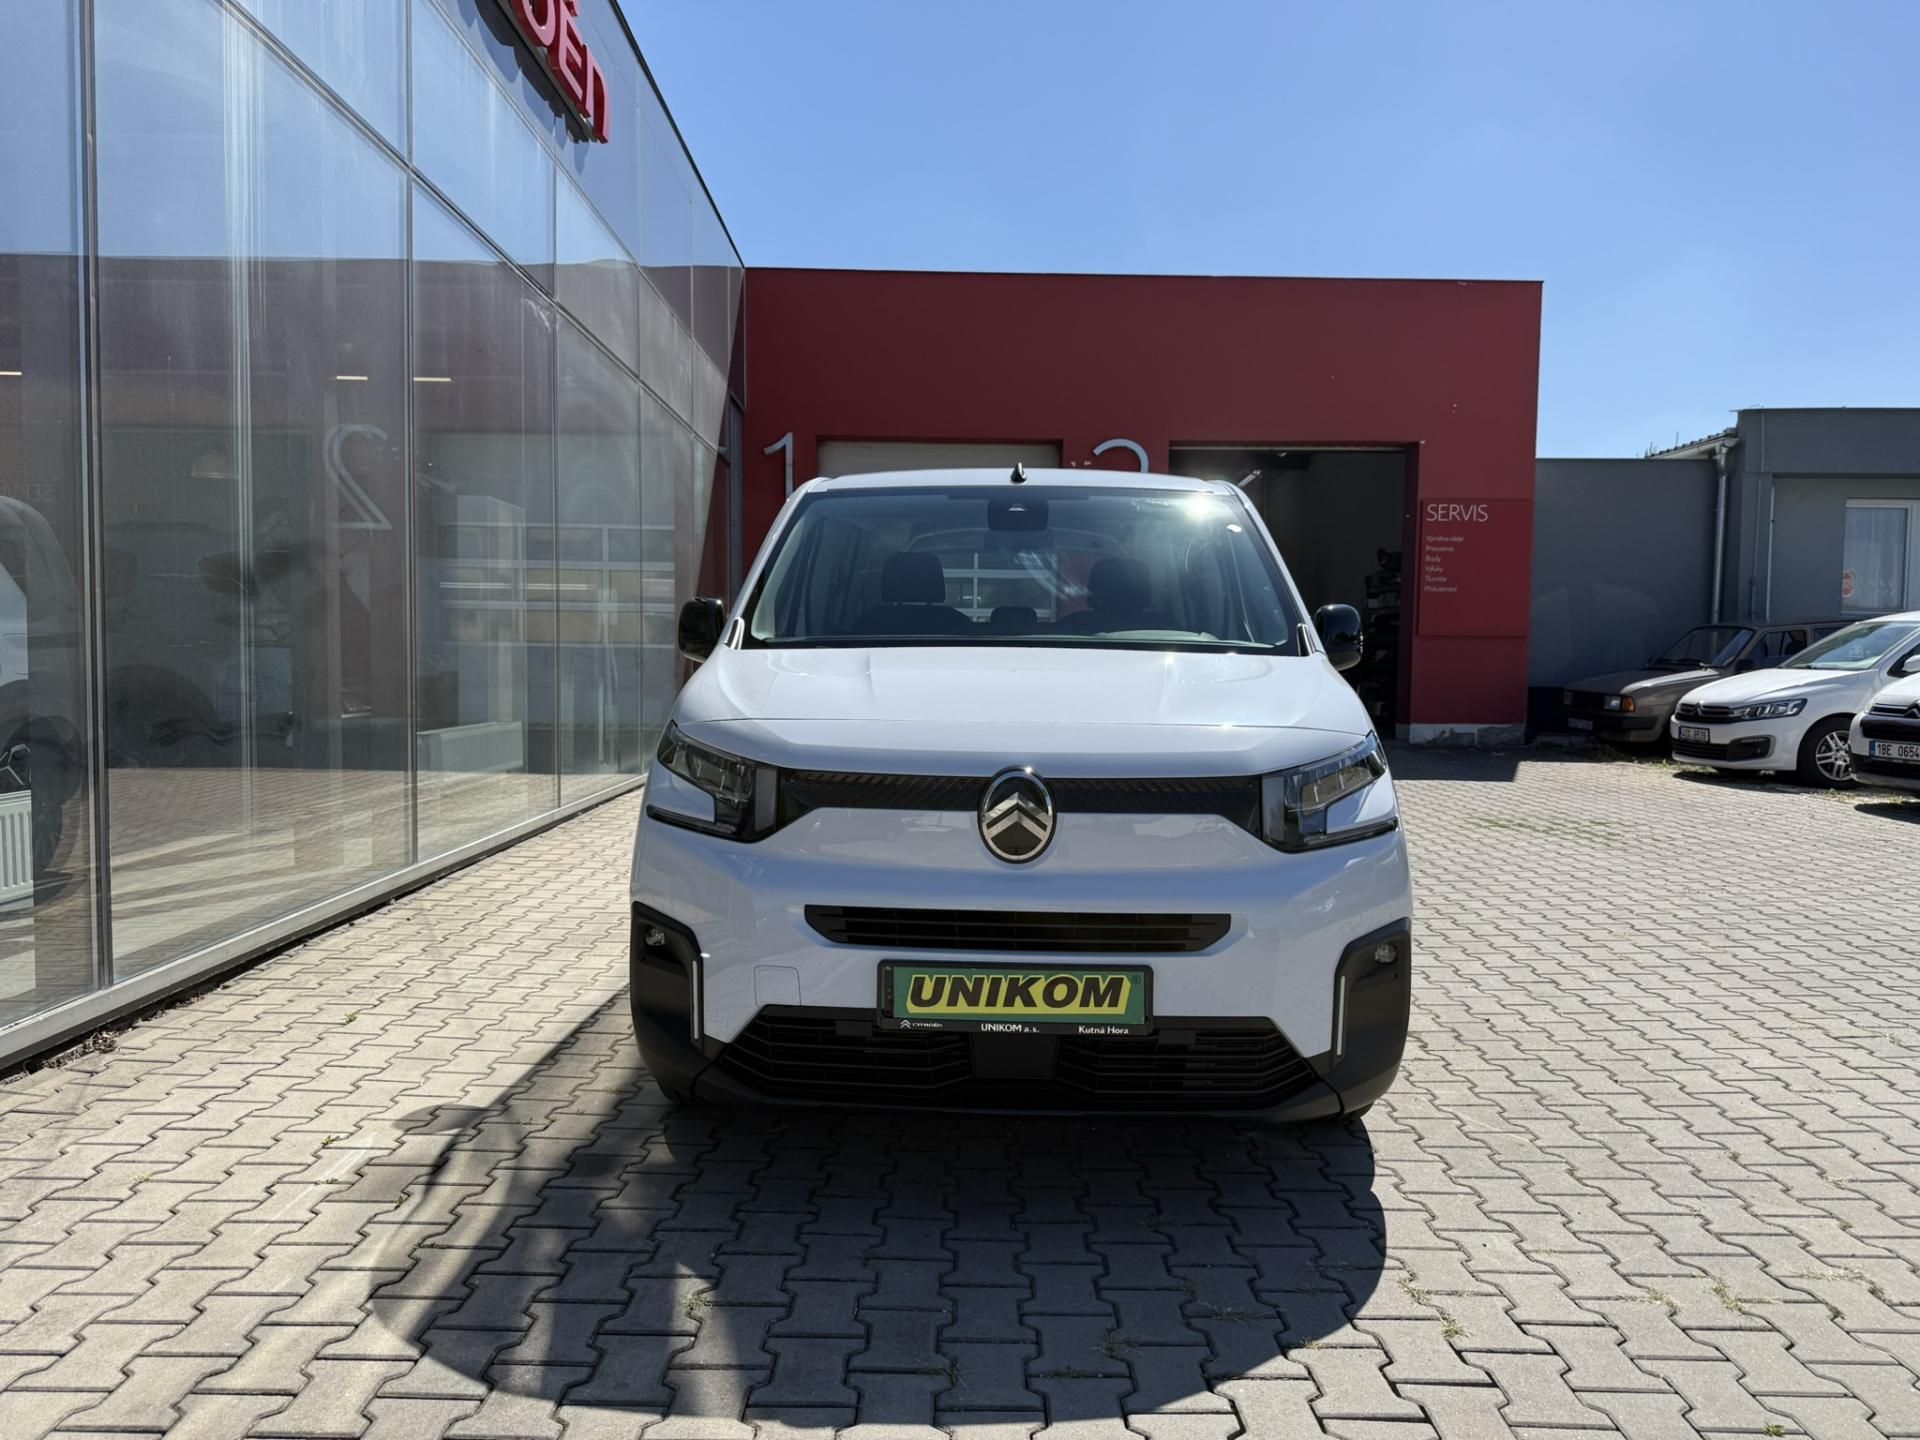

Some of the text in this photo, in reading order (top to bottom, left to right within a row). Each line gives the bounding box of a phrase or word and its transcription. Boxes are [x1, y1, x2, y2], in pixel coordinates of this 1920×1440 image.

[1426, 504, 1489, 522] SERVIS
[1877, 743, 1920, 759] 1BE 0654
[907, 975, 1128, 1011] UNIKOM
[981, 1023, 1022, 1032] UNIKOM
[1023, 1025, 1040, 1033] a.s.
[1078, 1025, 1105, 1034] Kutná
[1107, 1026, 1129, 1034] Hora
